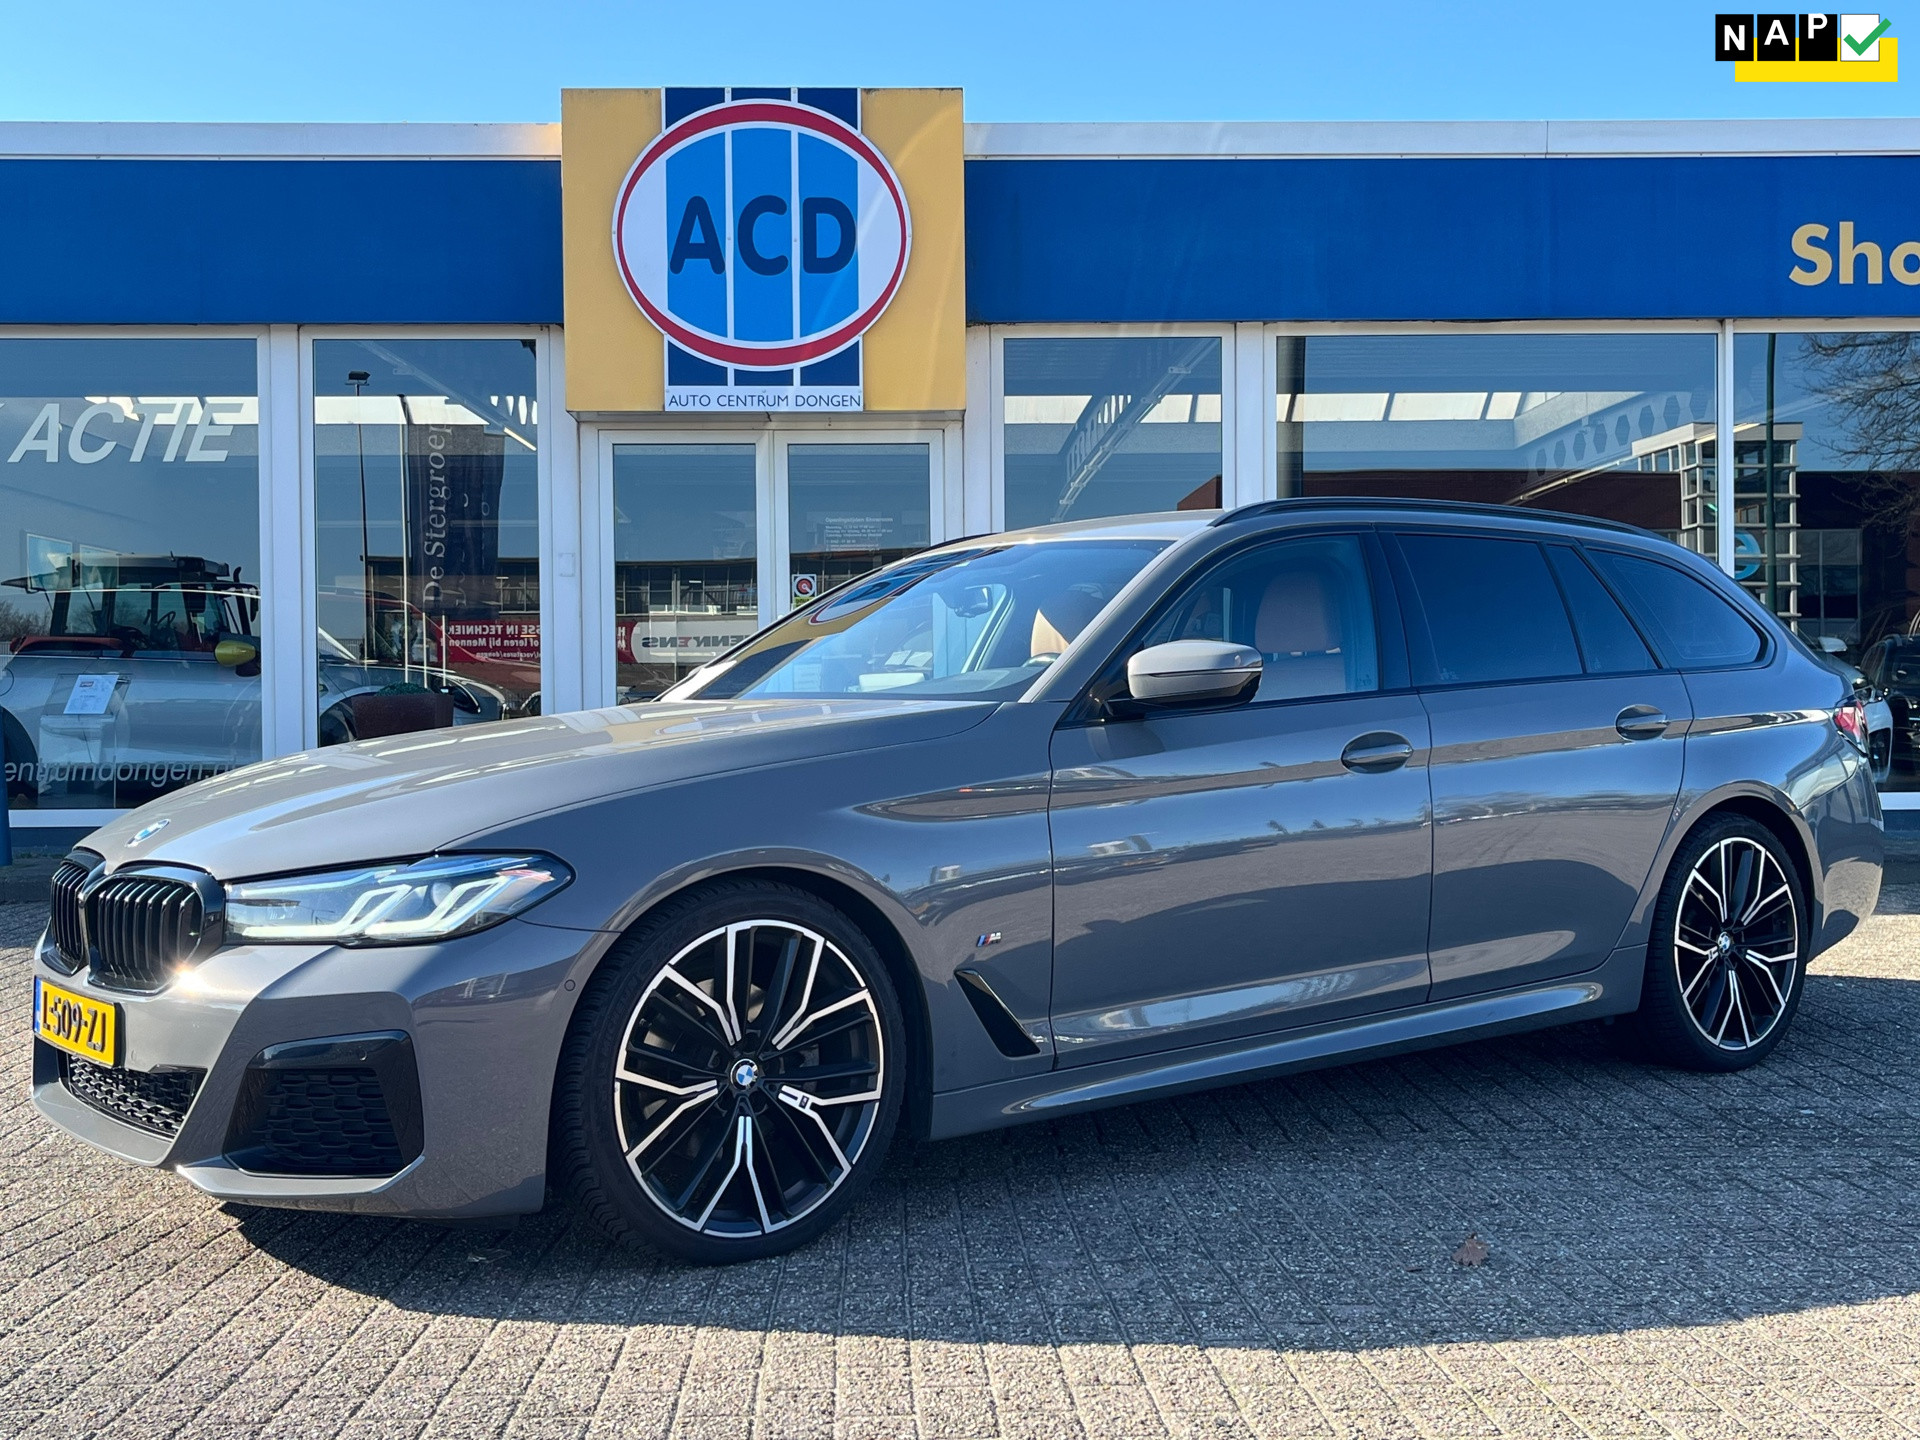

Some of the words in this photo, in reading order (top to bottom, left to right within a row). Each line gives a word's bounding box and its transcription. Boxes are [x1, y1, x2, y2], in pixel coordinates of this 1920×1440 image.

[669, 195, 857, 276] ACD
[1789, 222, 1920, 286] Sho
[668, 394, 712, 408] AUTO
[716, 394, 789, 408] CENTRUM
[795, 394, 861, 408] DONGEN
[7, 403, 244, 464] ACTIE
[423, 566, 445, 602] De
[43, 991, 106, 1053] L-509-ZJ
